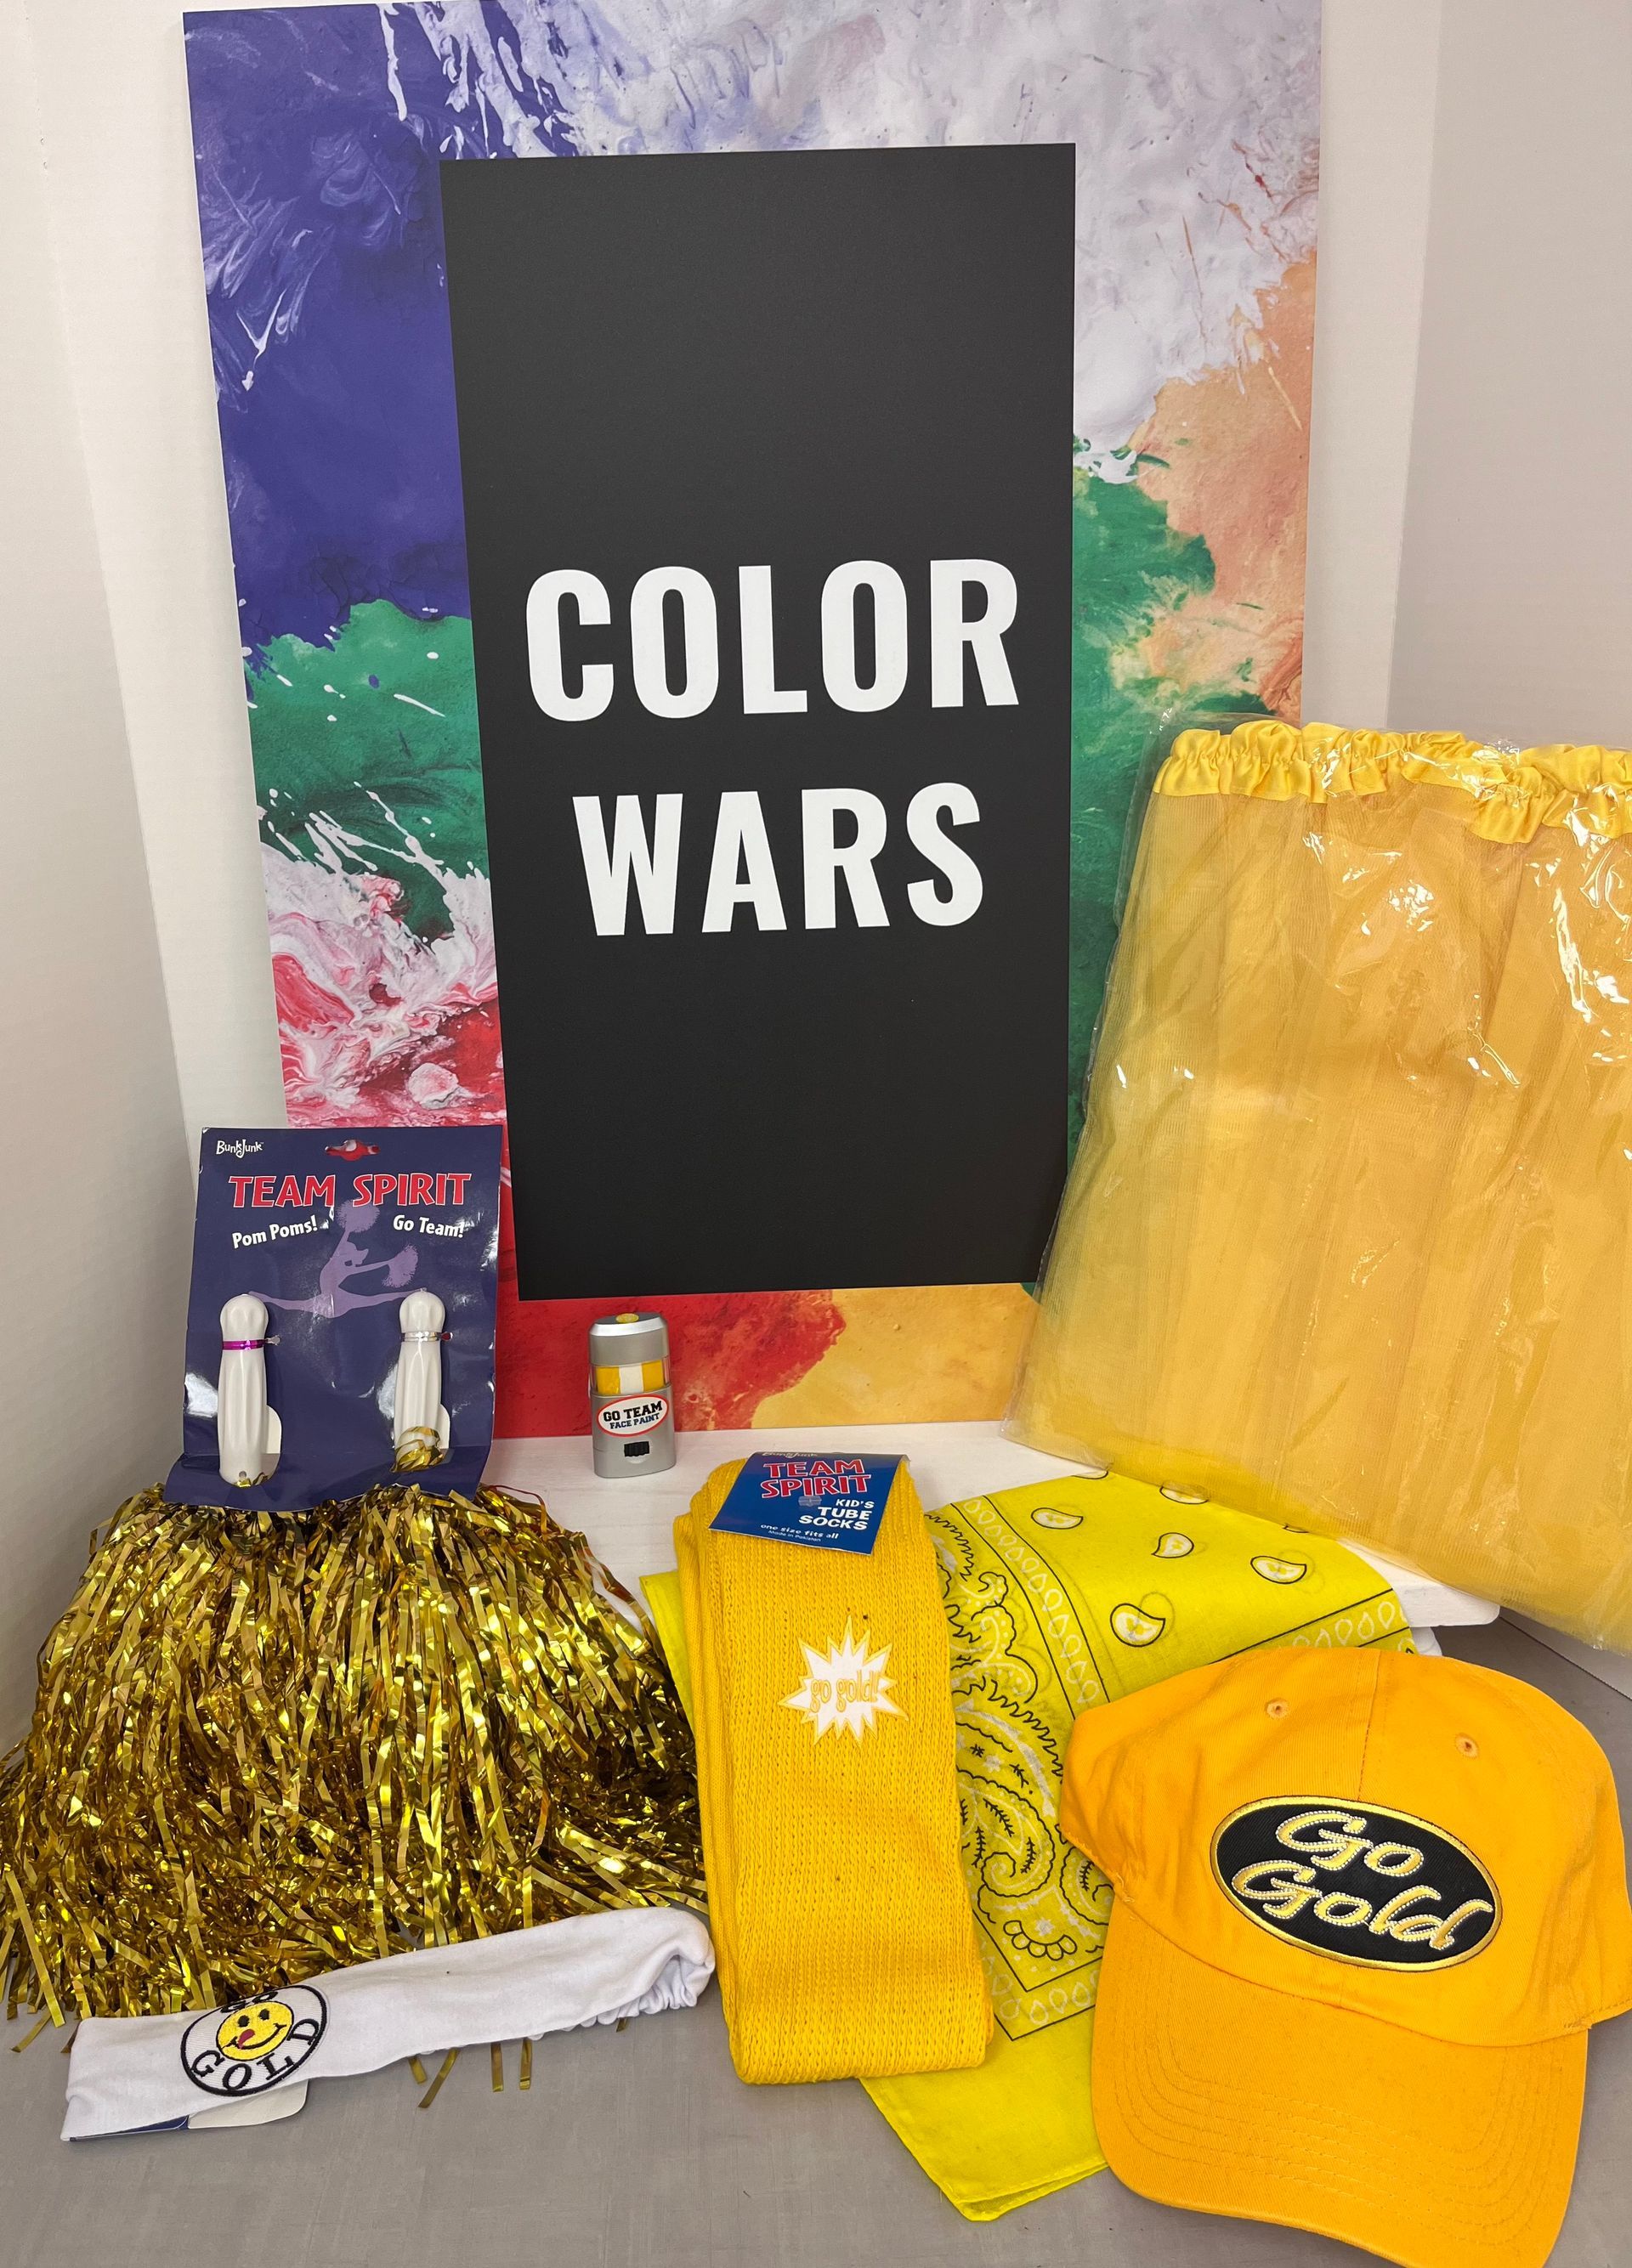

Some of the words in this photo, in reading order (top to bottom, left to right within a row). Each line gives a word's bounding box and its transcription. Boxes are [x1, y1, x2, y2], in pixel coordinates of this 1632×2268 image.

[526, 558, 1019, 721] COLOR
[572, 782, 983, 936] WARS
[228, 1174, 336, 1208] TEAM
[352, 1173, 472, 1207] SPIRIT
[231, 1228, 267, 1248] Pom
[269, 1215, 318, 1241] Poms!
[393, 1215, 415, 1233] Go
[418, 1217, 464, 1238] Team!
[604, 1410, 620, 1422] GO
[623, 1400, 662, 1418] TEAM
[609, 1420, 632, 1428] FACE
[633, 1412, 660, 1425] PAINT
[763, 1459, 865, 1479] TEAM
[760, 1474, 871, 1498] SPIRIT
[818, 1507, 872, 1520] TUBE
[836, 1499, 875, 1508] KID'S
[798, 1515, 868, 1530] SOCKS
[810, 1679, 832, 1713] go
[1275, 1810, 1425, 1876] Go
[1232, 1859, 1493, 1950] Gold
[190, 2018, 320, 2090] GOLD
